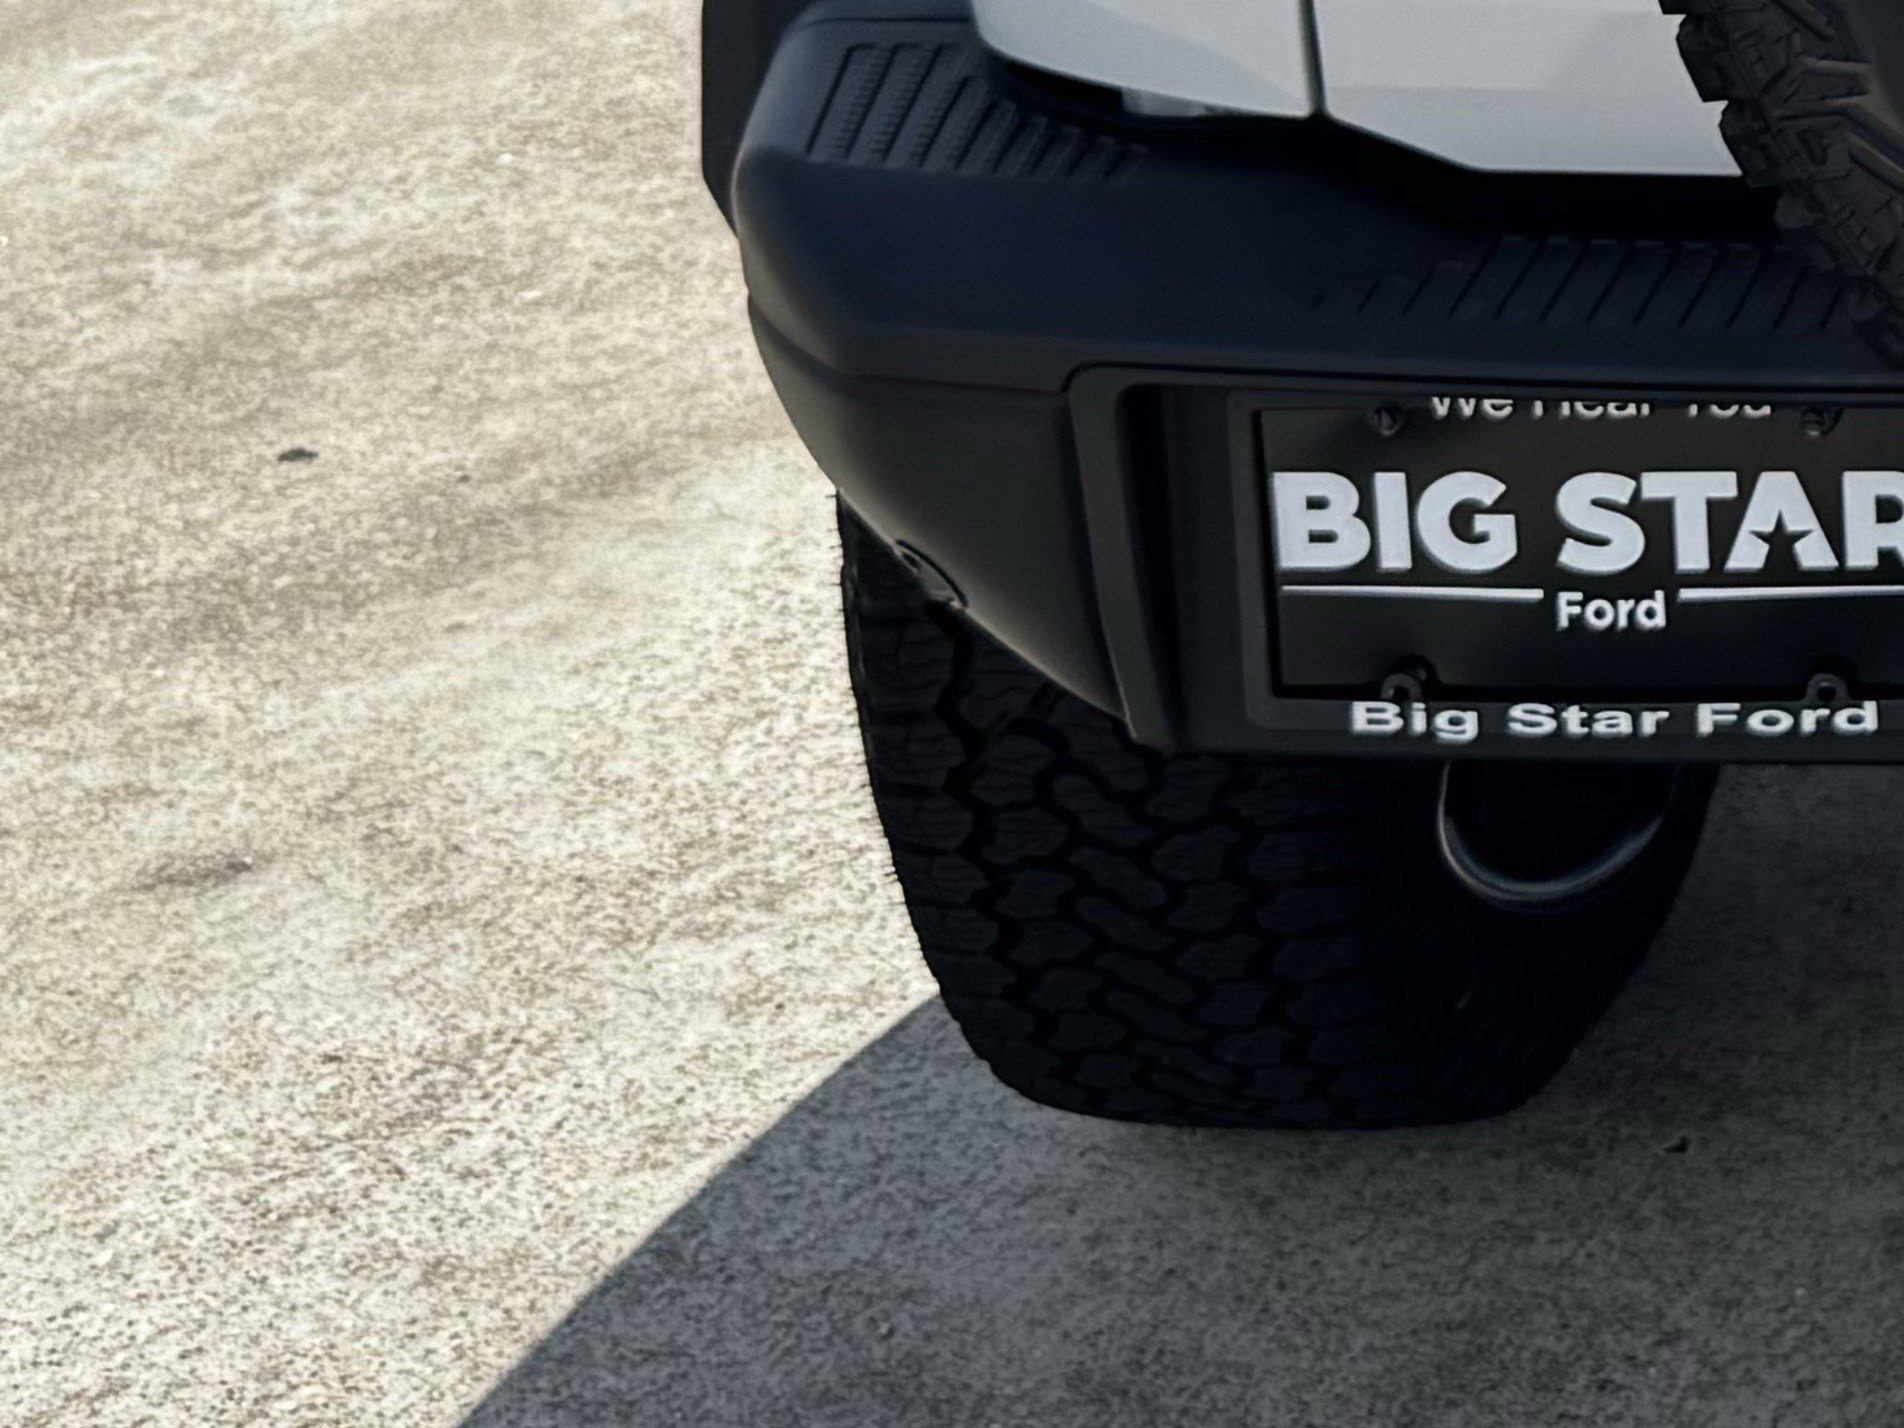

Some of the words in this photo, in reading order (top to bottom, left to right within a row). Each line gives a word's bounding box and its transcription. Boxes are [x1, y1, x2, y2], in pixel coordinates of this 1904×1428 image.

[1272, 471, 1519, 573] BIG
[1556, 589, 1668, 632] Ford
[1349, 700, 1481, 743] Big
[1506, 701, 1670, 737] Star
[1695, 700, 1880, 737] Ford
